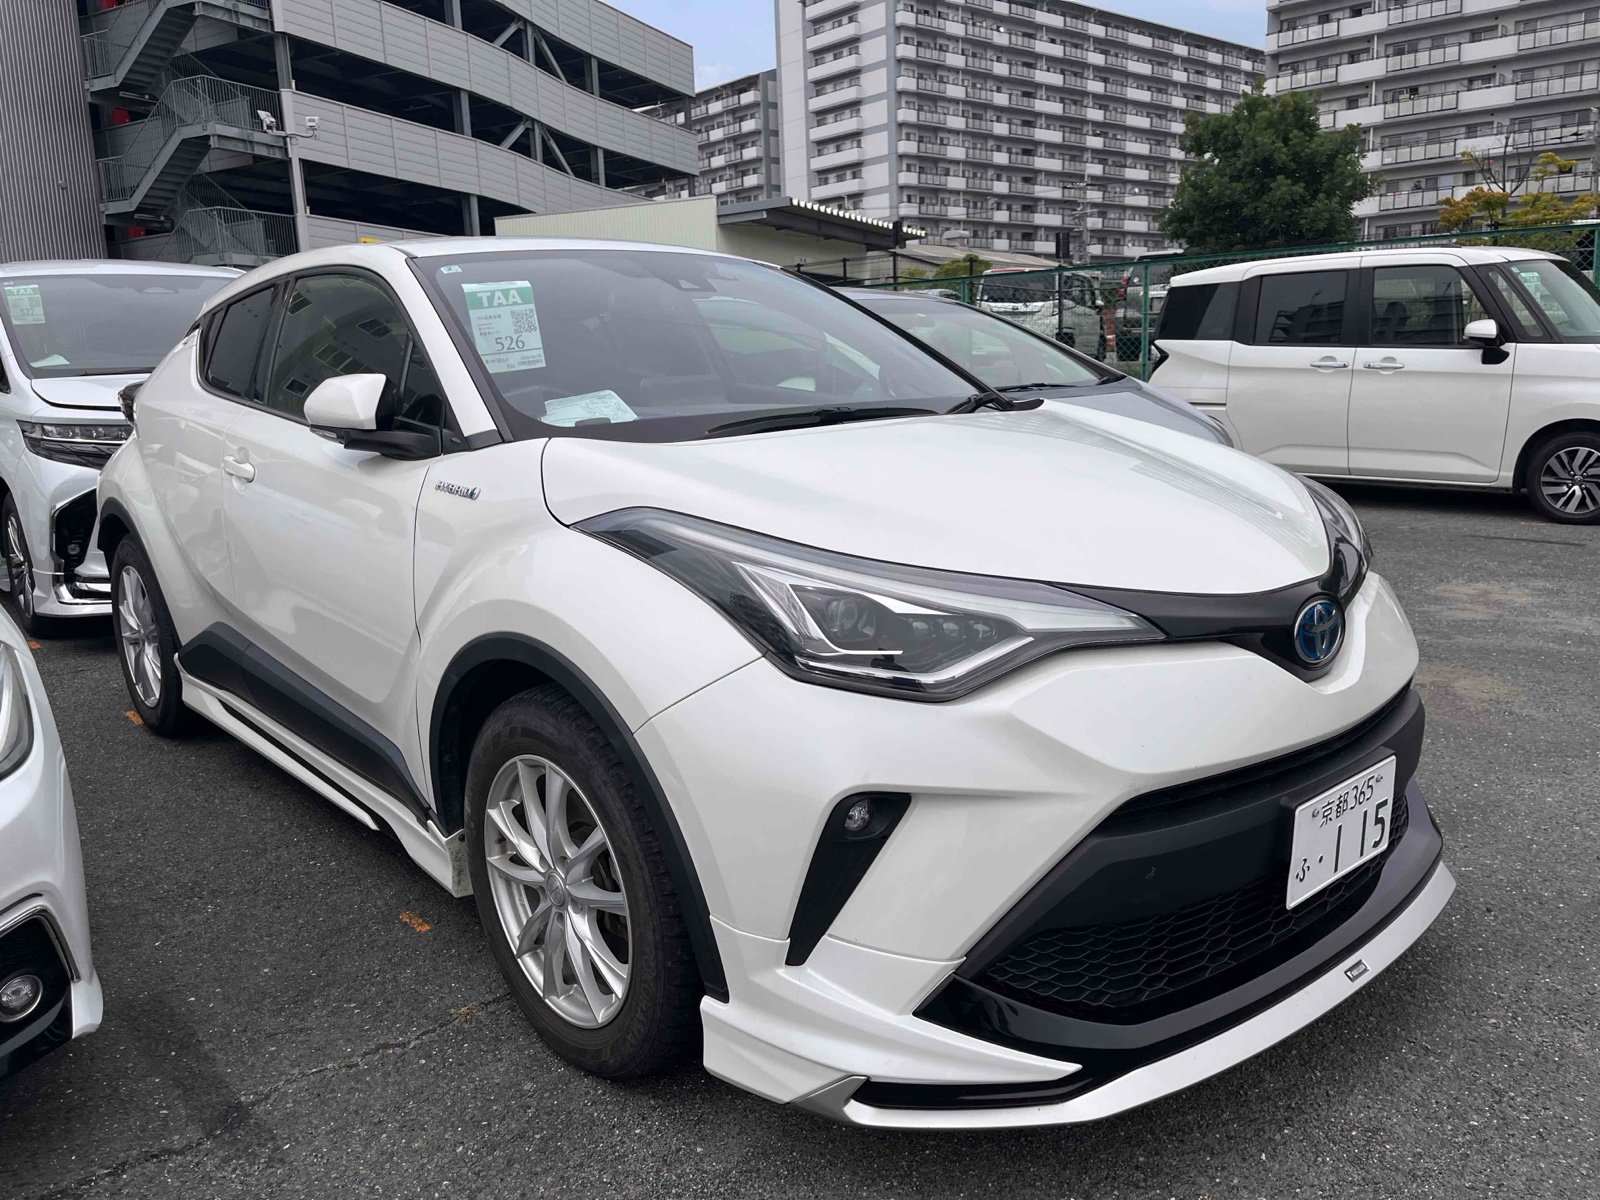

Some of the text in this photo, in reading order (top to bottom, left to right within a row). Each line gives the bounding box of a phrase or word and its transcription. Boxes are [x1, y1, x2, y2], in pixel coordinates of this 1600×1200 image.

[11, 288, 34, 296] TAA
[477, 289, 523, 307] TAA
[19, 308, 35, 316] 527
[495, 334, 526, 352] 526
[434, 480, 472, 499] HYBRID
